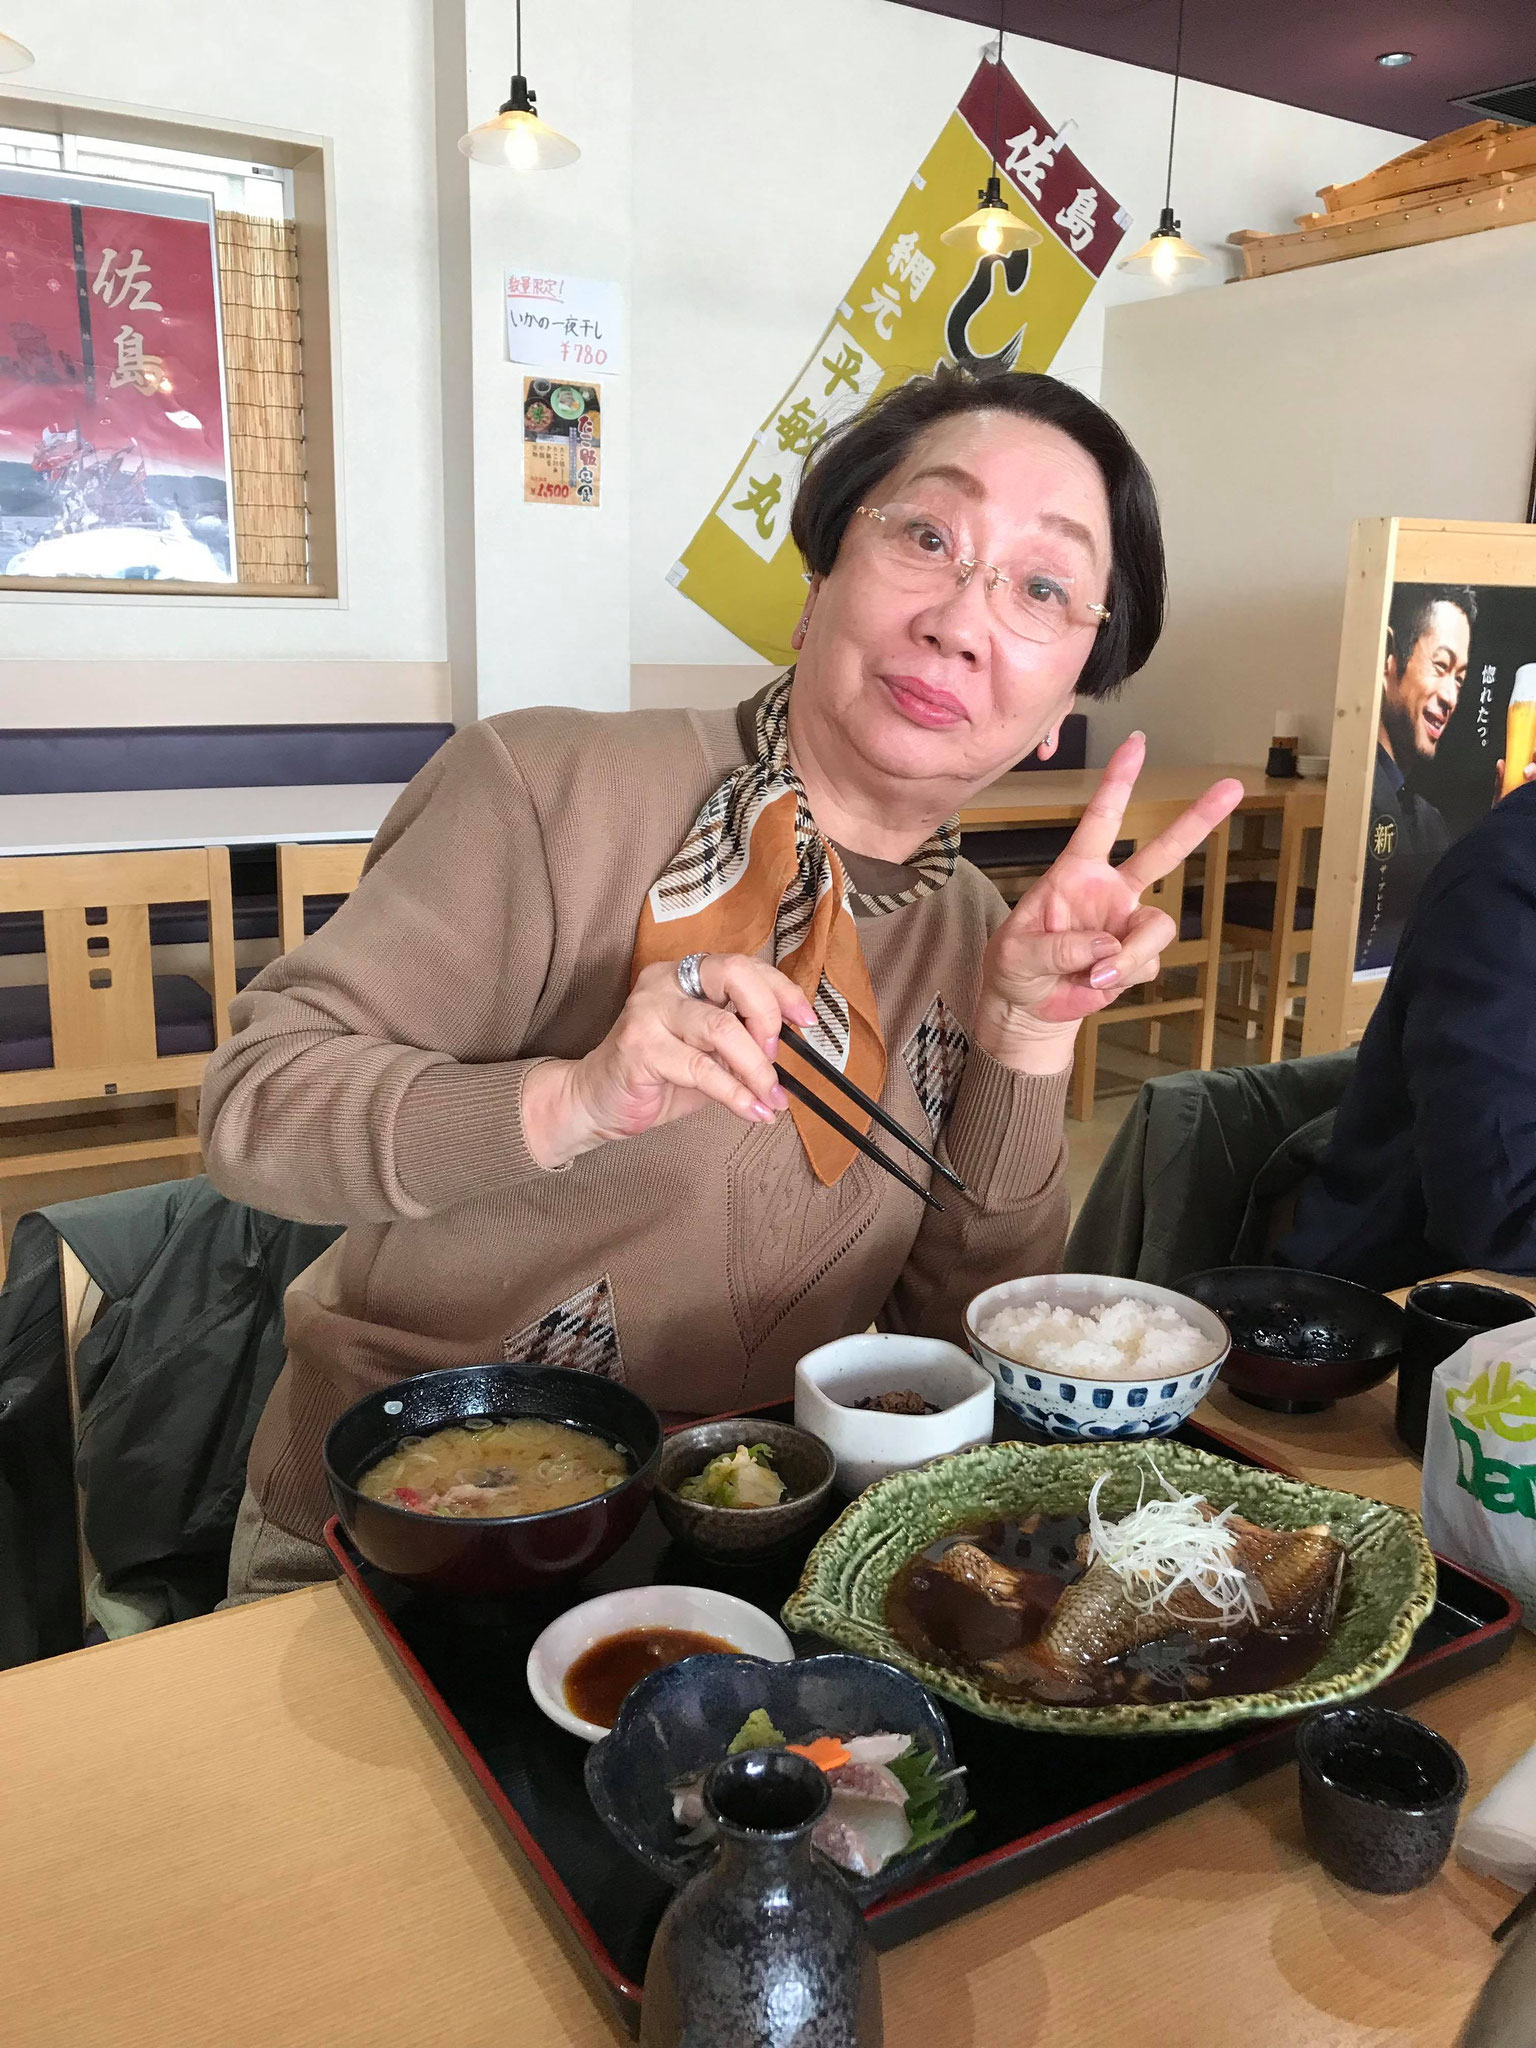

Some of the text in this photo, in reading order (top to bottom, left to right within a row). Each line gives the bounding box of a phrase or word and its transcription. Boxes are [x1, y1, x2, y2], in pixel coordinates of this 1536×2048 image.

[1004, 125, 1098, 252] 佐島
[861, 231, 936, 340] 網元
[92, 248, 166, 397] 佐島
[510, 309, 602, 340] いかの一夜干し
[561, 340, 607, 365] ¥780
[1373, 823, 1395, 854] 新
